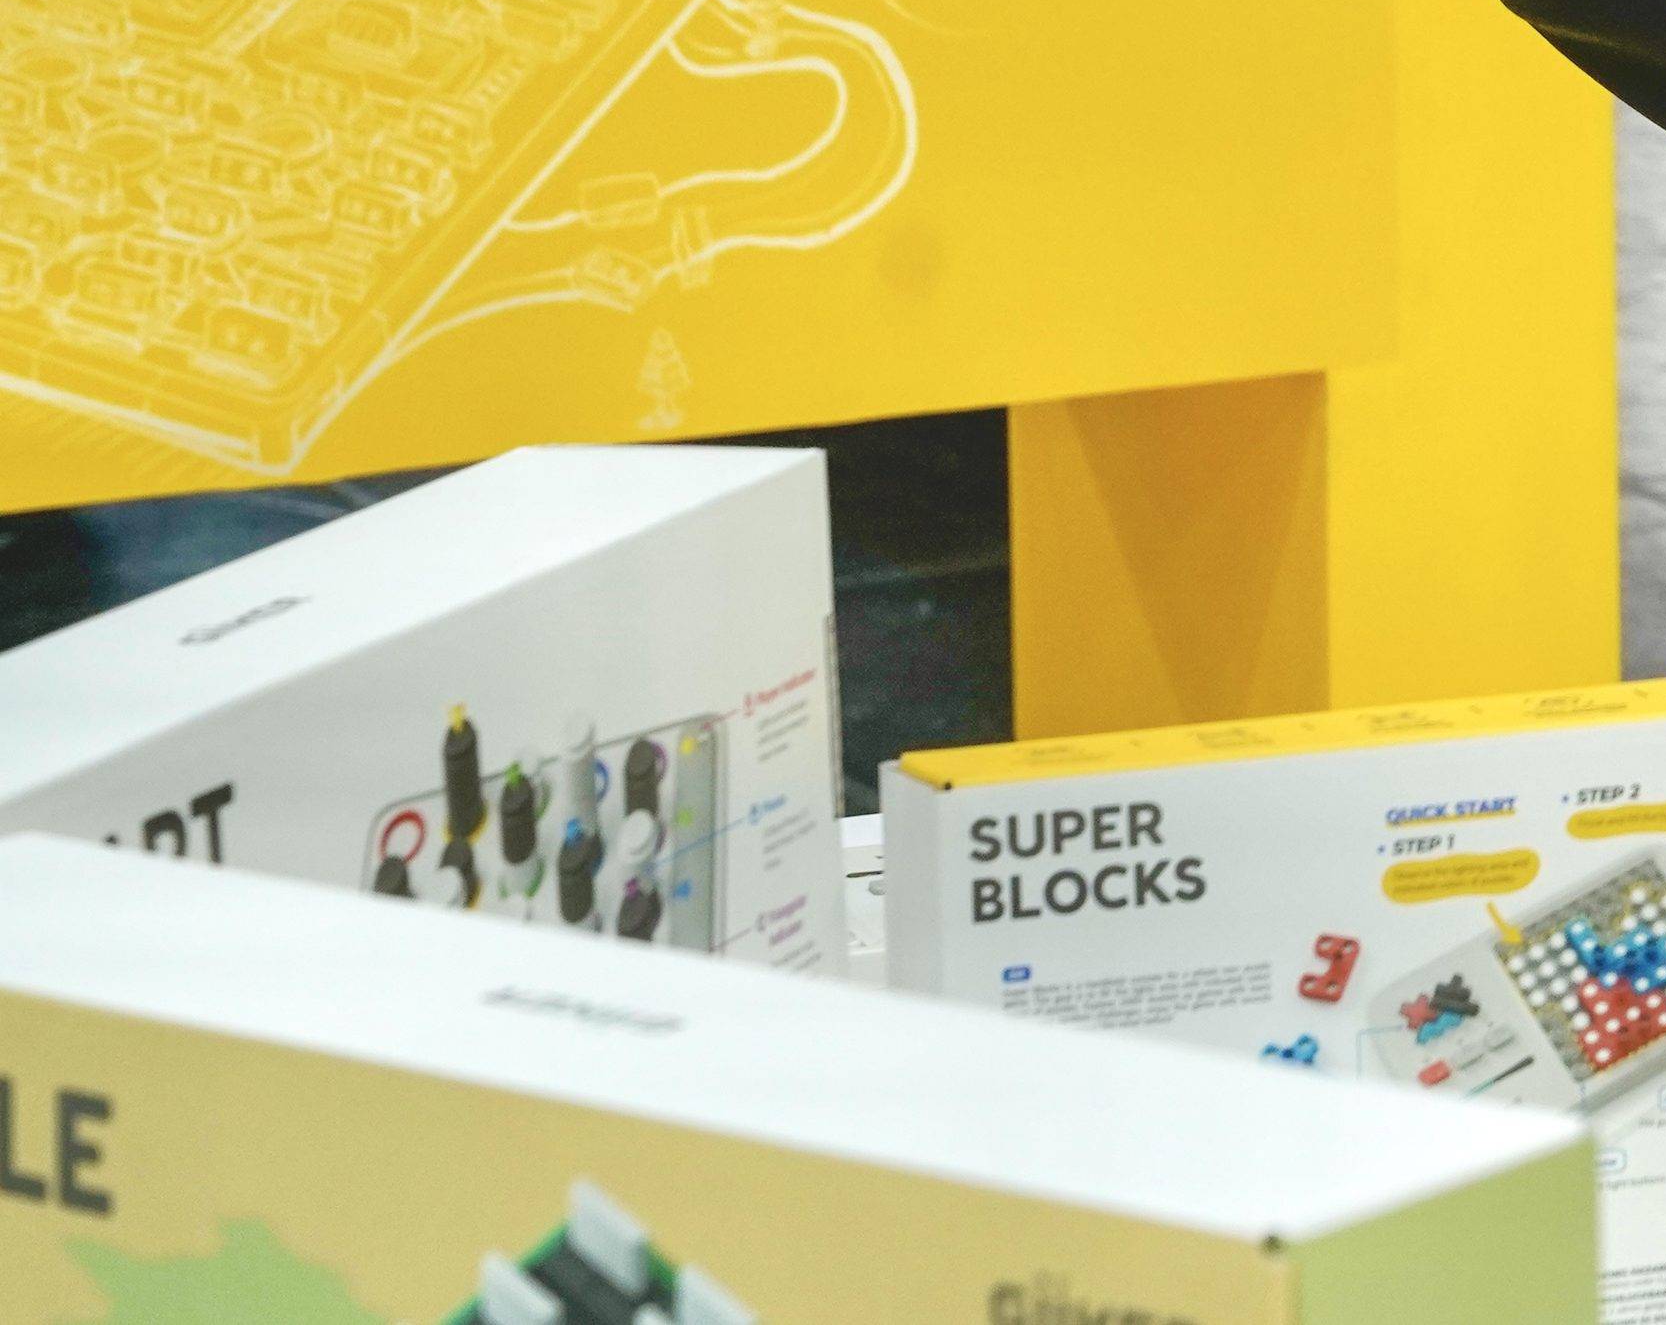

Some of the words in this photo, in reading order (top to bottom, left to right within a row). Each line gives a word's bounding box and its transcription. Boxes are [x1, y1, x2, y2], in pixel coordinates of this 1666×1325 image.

[1575, 786, 1626, 805] STEP
[1627, 782, 1643, 800] 2
[1385, 803, 1447, 827] QUICK
[1454, 795, 1517, 817] START
[969, 801, 1163, 863] SUPER
[1391, 836, 1443, 856] STEP
[1447, 833, 1457, 851] 1
[972, 855, 1207, 924] BLOCKS
